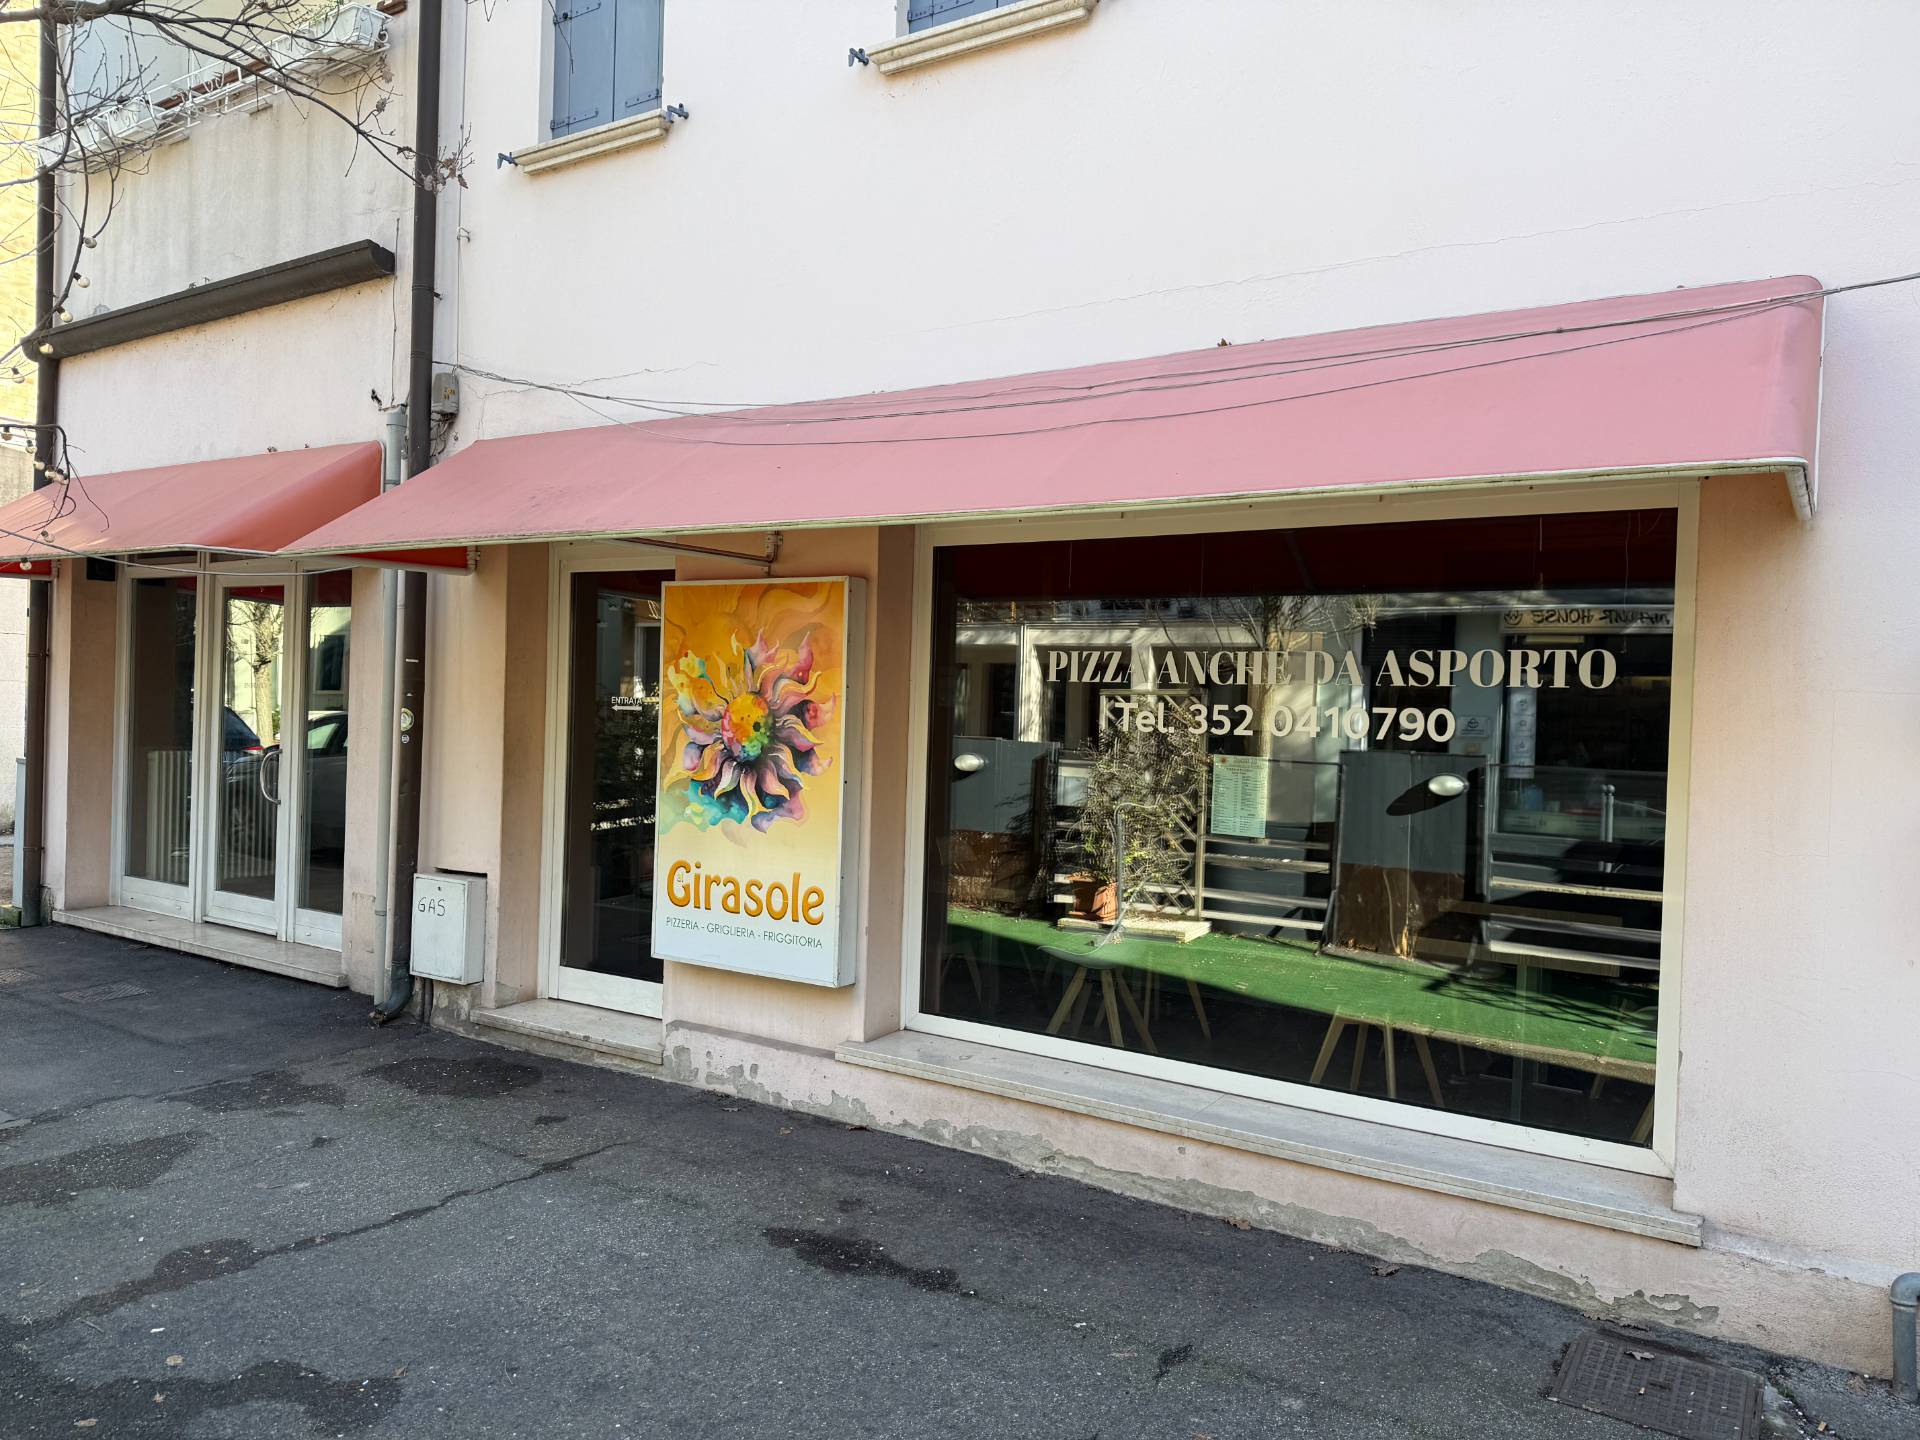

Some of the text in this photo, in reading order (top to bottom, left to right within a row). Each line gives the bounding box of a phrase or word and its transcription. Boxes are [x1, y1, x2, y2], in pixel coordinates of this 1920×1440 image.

[1047, 649, 1617, 690] PIZZA ANCHE DA ASPORTO
[611, 696, 643, 705] ENTRATA
[1114, 702, 1456, 743] Tel. 352 0410790
[418, 897, 446, 917] GAS
[666, 859, 825, 925] Girasole
[666, 916, 700, 931] PIZZERIA
[706, 922, 756, 939] GRIGLIERIA
[763, 930, 823, 949] FRIGGITORIA
